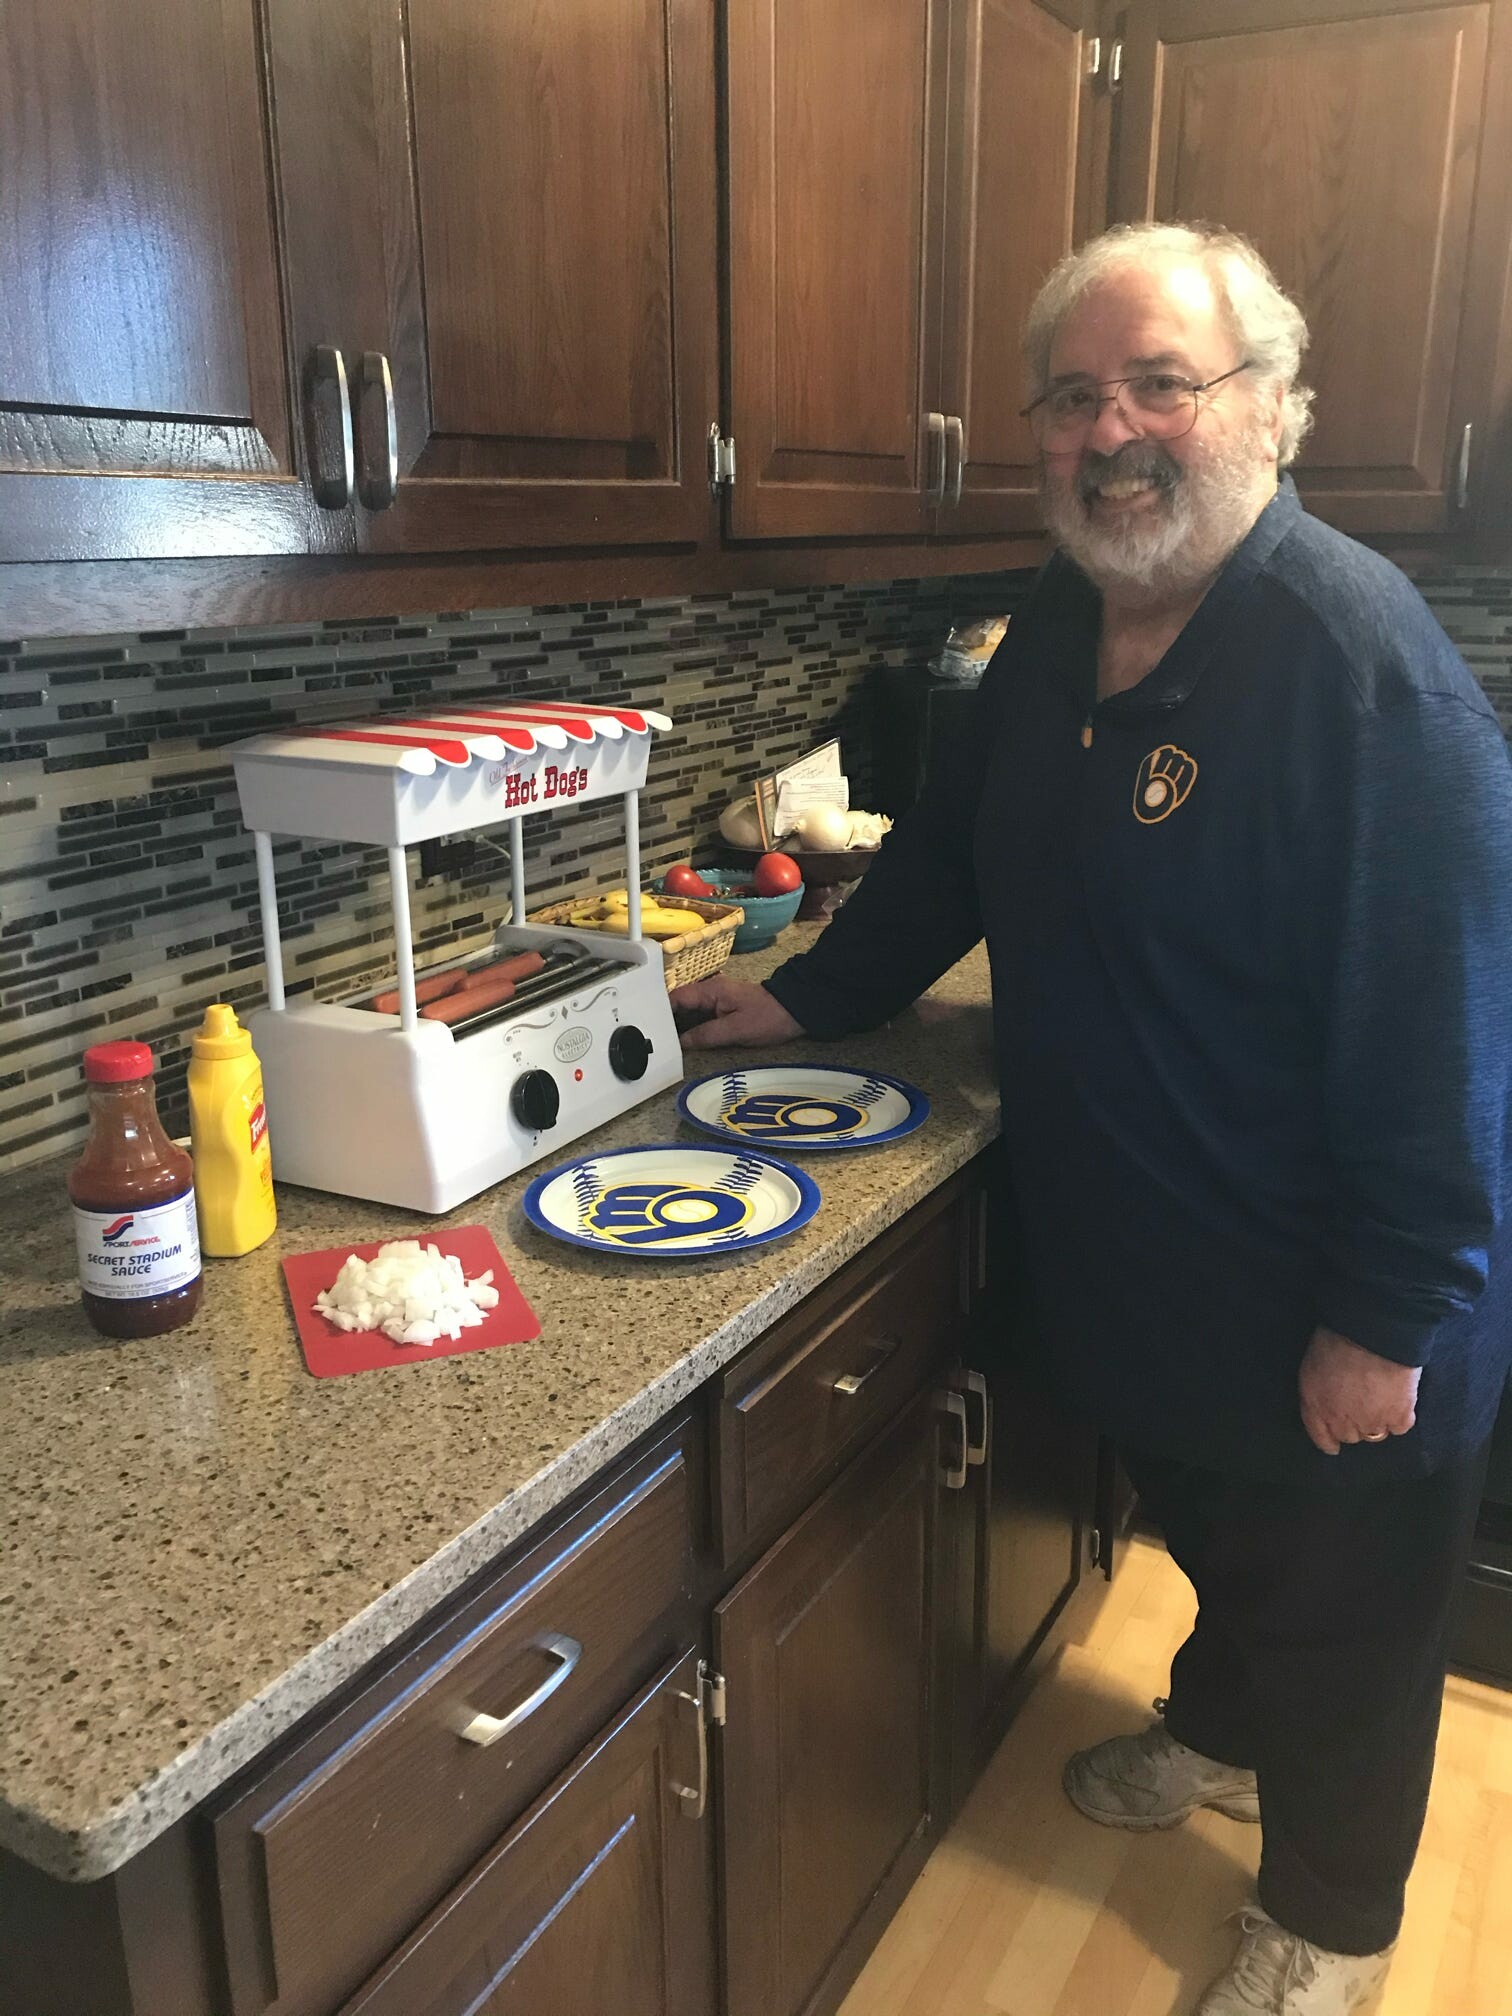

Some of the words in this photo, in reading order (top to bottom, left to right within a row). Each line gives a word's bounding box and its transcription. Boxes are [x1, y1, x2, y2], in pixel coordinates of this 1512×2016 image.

[505, 772, 538, 808] Hot
[87, 1253, 125, 1266] SECRET
[128, 1243, 182, 1266] STADIUM
[111, 1263, 152, 1277] SAUCE
